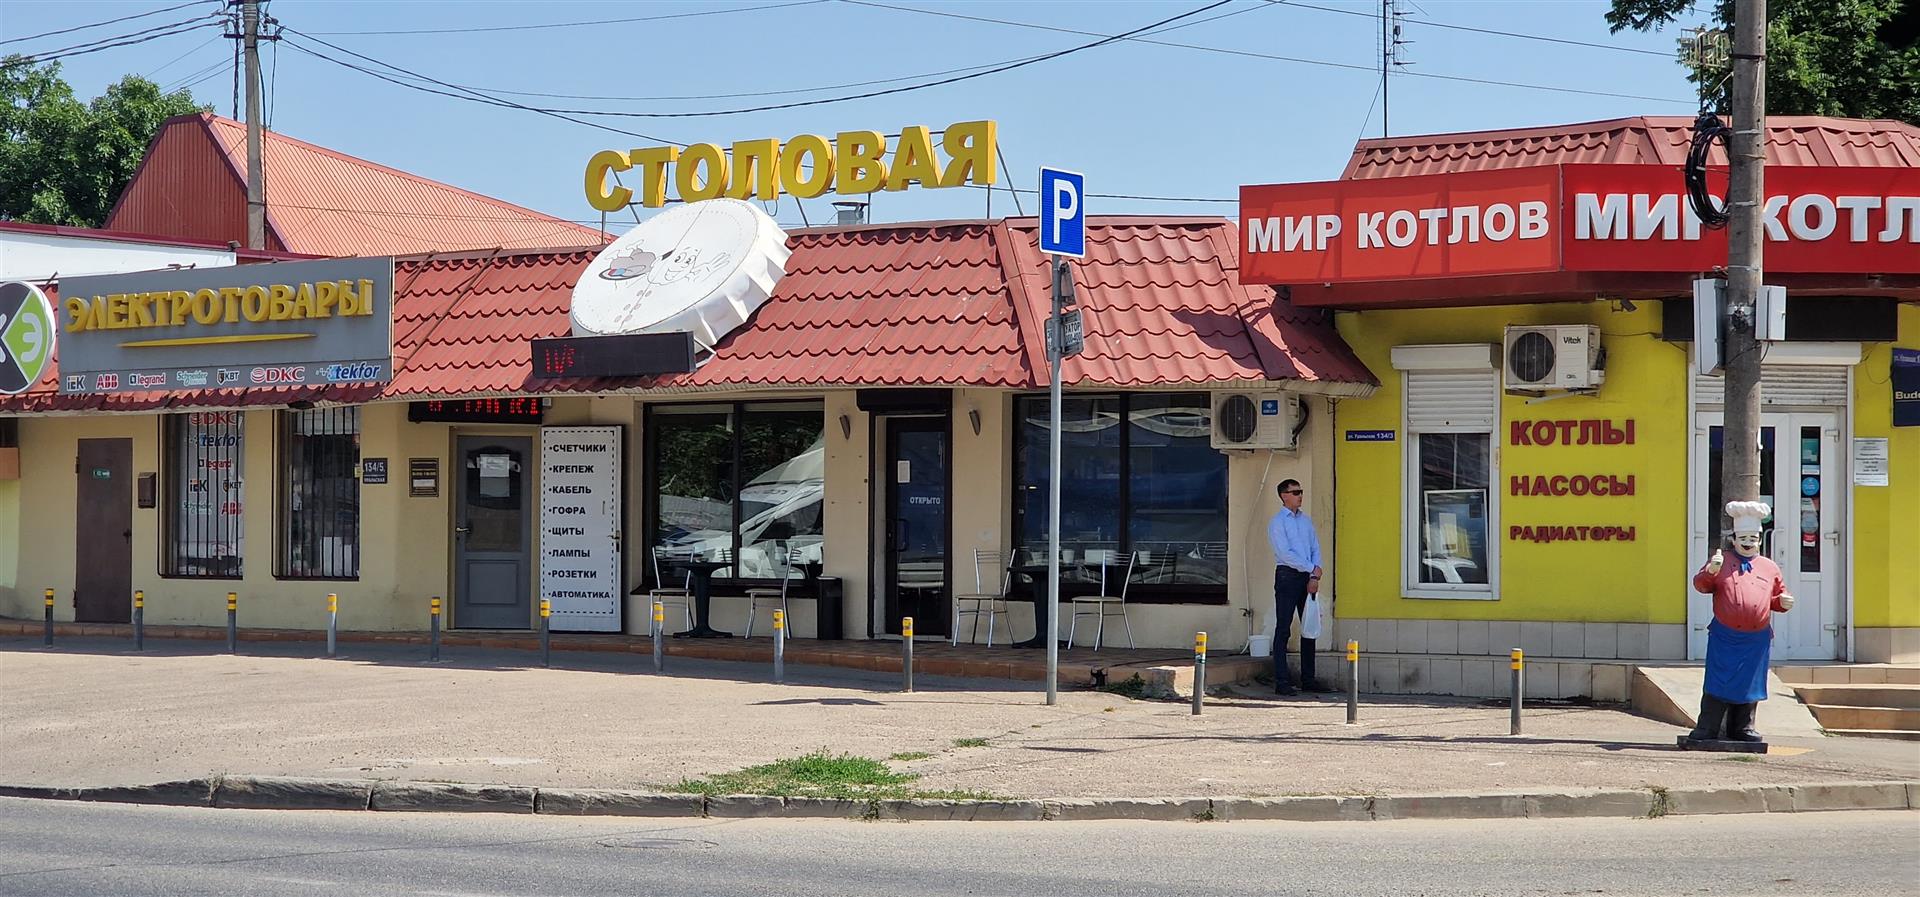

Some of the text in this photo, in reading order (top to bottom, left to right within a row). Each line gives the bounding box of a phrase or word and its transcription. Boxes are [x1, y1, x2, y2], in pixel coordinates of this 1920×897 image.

[585, 120, 996, 212] СТОЛОВАЯ
[1247, 201, 1550, 253] МИР КОТЛОВ
[65, 279, 374, 332] ЭЛЕКТРОТОВАРЫ
[267, 367, 305, 382] DKC
[335, 361, 381, 381] tekfor
[96, 374, 118, 390] ABB
[137, 372, 165, 388] legrand
[1510, 419, 1635, 446] КОТЛЫ
[552, 444, 607, 453] СЧЕТЧИКИ
[206, 459, 232, 470] egand
[552, 465, 594, 473] КРЕПЕЖ
[552, 486, 592, 494] КАБЕЛЬ
[1510, 475, 1635, 496] НАСОСЫ
[909, 496, 941, 505] ОТКРЫТО
[552, 506, 586, 515] ГОФРА
[552, 527, 584, 536] ЩИТЫ
[1509, 526, 1636, 543] РАДИАТОРЫ
[552, 549, 590, 557] ЛАМПЫ
[551, 570, 597, 578] РОЗЕТКИ
[551, 591, 611, 599] АВТОМАТИКА
